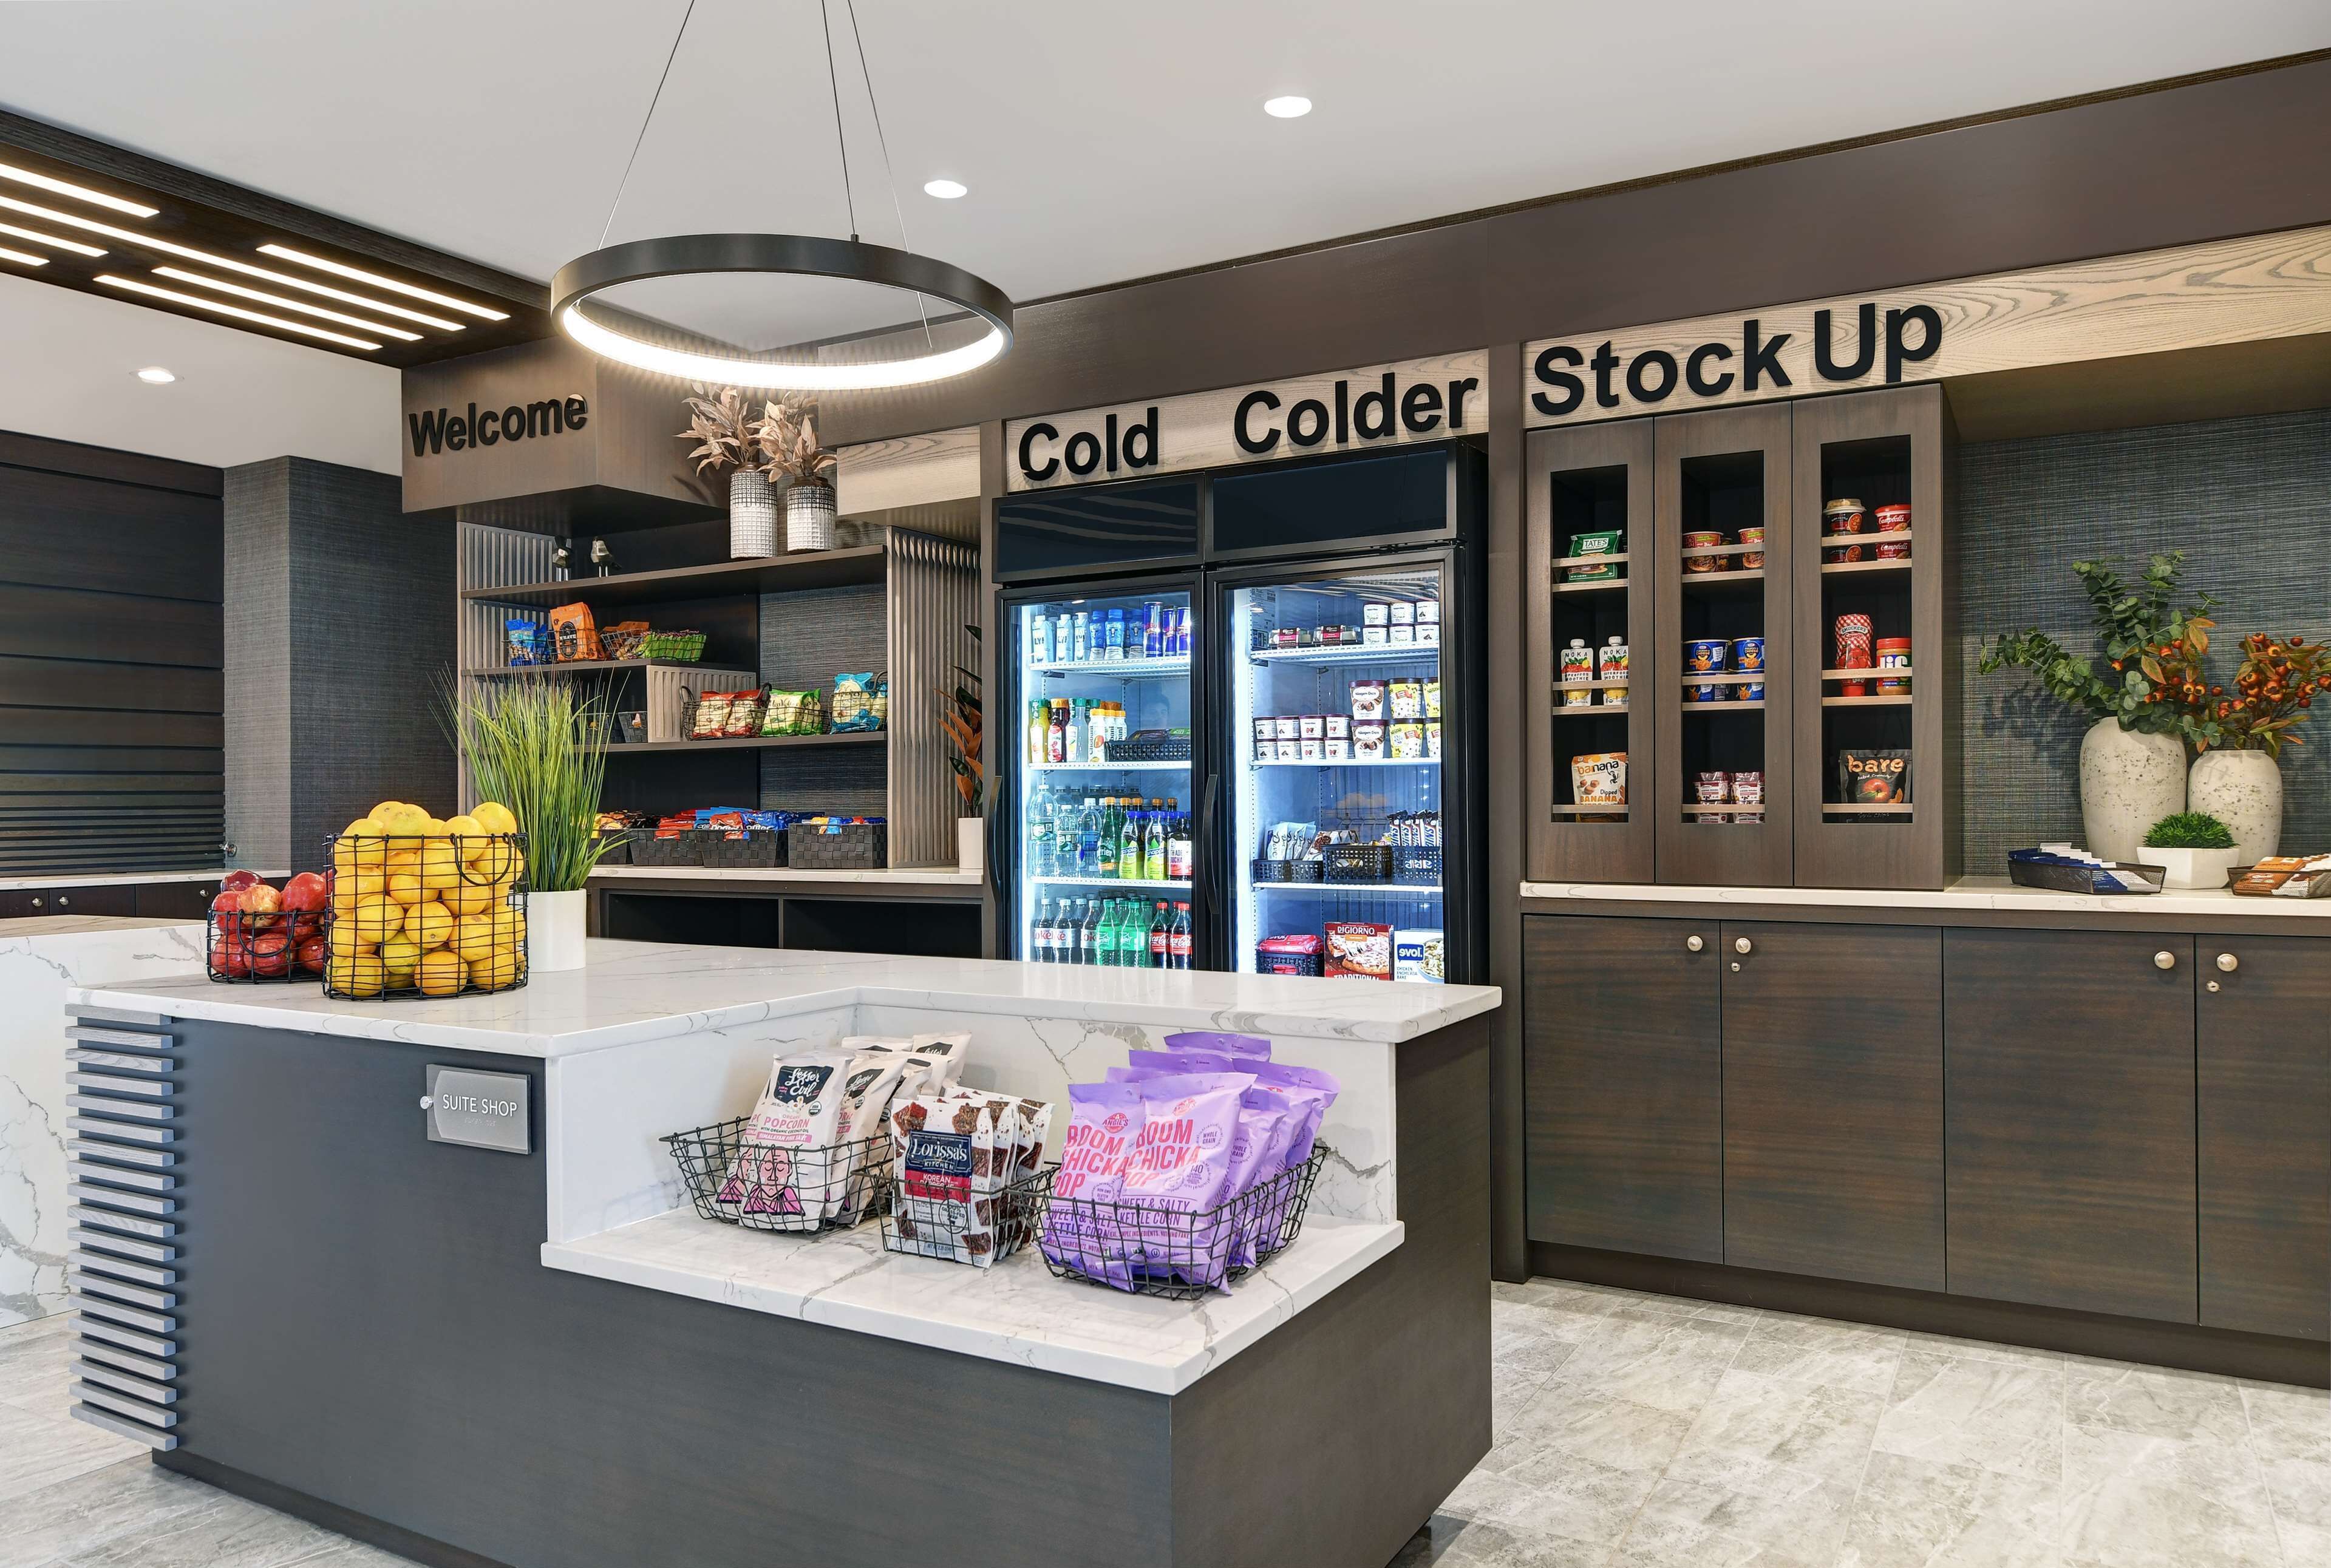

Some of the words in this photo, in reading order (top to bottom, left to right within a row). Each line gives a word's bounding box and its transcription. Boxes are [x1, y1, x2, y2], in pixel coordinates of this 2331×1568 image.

[1531, 319, 1792, 416] Stock
[1814, 303, 1942, 382] Up
[1234, 373, 1479, 454] Colder
[409, 393, 588, 457] Welcome
[1018, 407, 1159, 481] Cold
[1847, 755, 1904, 773] bare
[1337, 926, 1375, 935] DIGIORNO
[784, 1068, 820, 1086] Lesser
[443, 1094, 478, 1113] SUITE
[482, 1098, 517, 1118] SHOP
[763, 1116, 810, 1129] POPCORN
[1102, 1118, 1129, 1127] ANGIE'S
[1064, 1124, 1126, 1156] BOOM
[1136, 1119, 1194, 1149] BOOM
[911, 1138, 967, 1162] Lorissa's
[1129, 1145, 1202, 1171] CHICKA
[924, 1161, 955, 1170] KITCHEN
[1060, 1147, 1129, 1176] CHICKA
[1190, 1164, 1204, 1173] 140
[923, 1173, 951, 1184] KOREAN
[1055, 1172, 1086, 1198] POP
[1117, 1198, 1146, 1210] SWEET
[1148, 1198, 1155, 1209] &
[1158, 1198, 1190, 1212] SALTY
[1079, 1210, 1087, 1223] &
[1152, 1212, 1181, 1226] CORN
